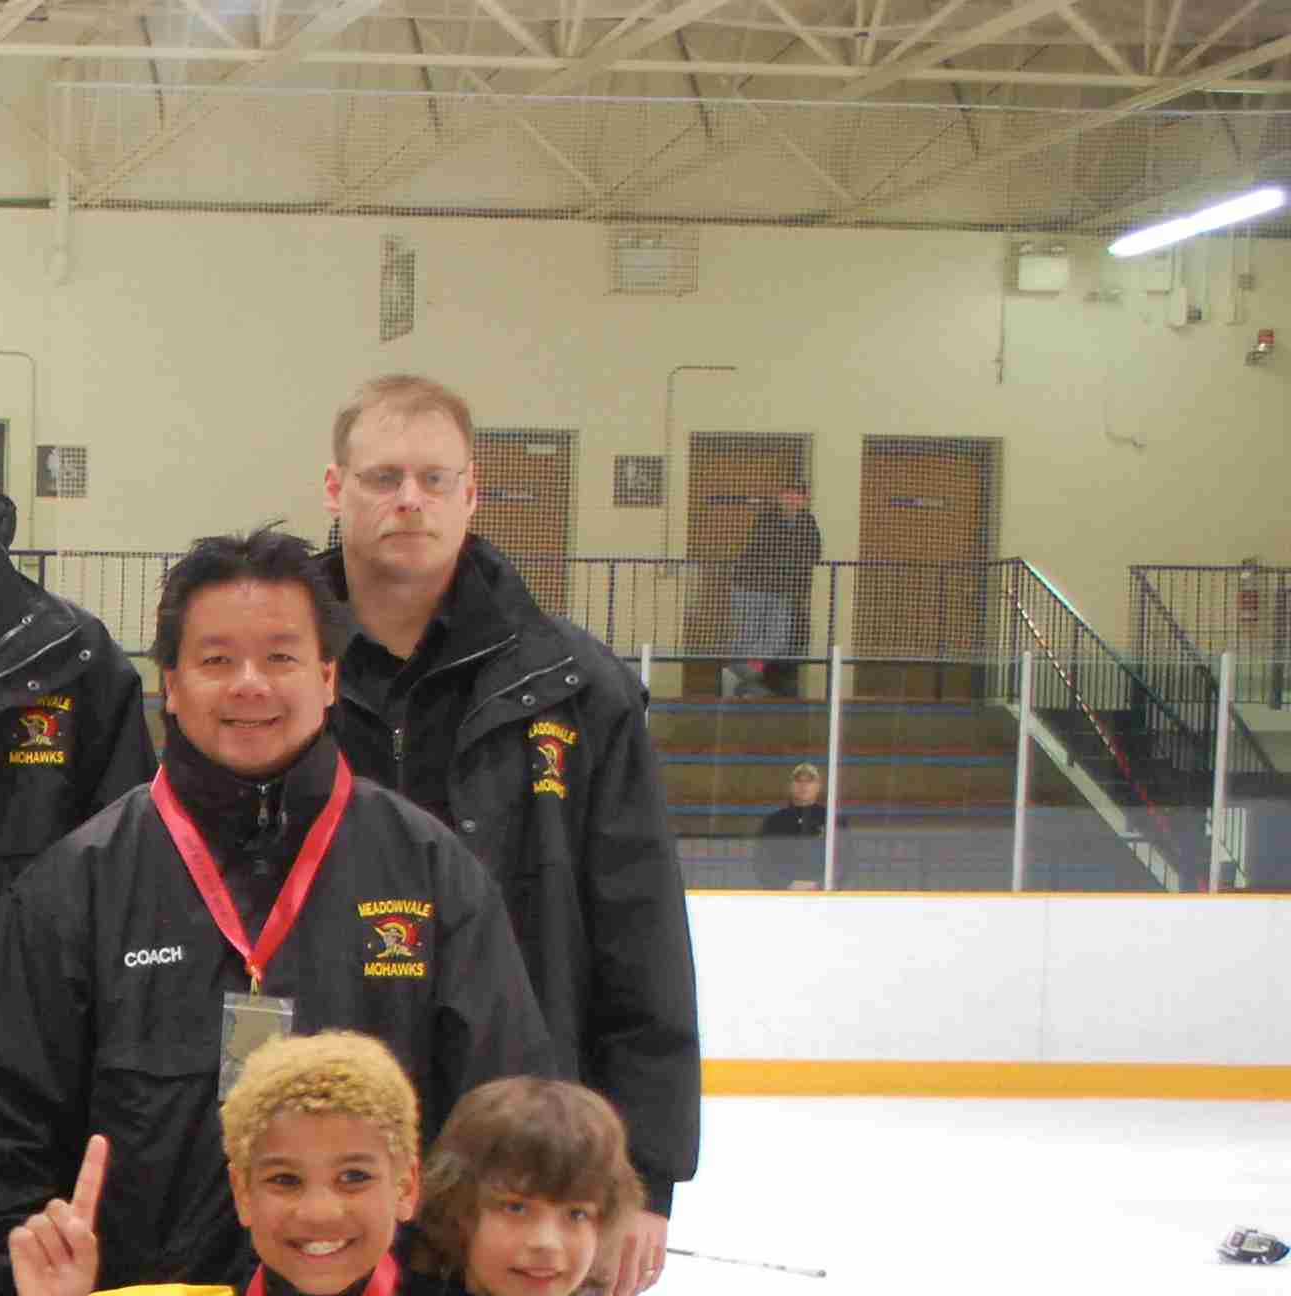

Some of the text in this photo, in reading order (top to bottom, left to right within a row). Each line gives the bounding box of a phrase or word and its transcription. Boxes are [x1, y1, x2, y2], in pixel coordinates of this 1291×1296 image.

[9, 751, 66, 765] MOHAWKS
[357, 899, 433, 917] MEADOWVALE
[124, 945, 183, 968] COACH
[364, 962, 425, 977] MOHAWKS
